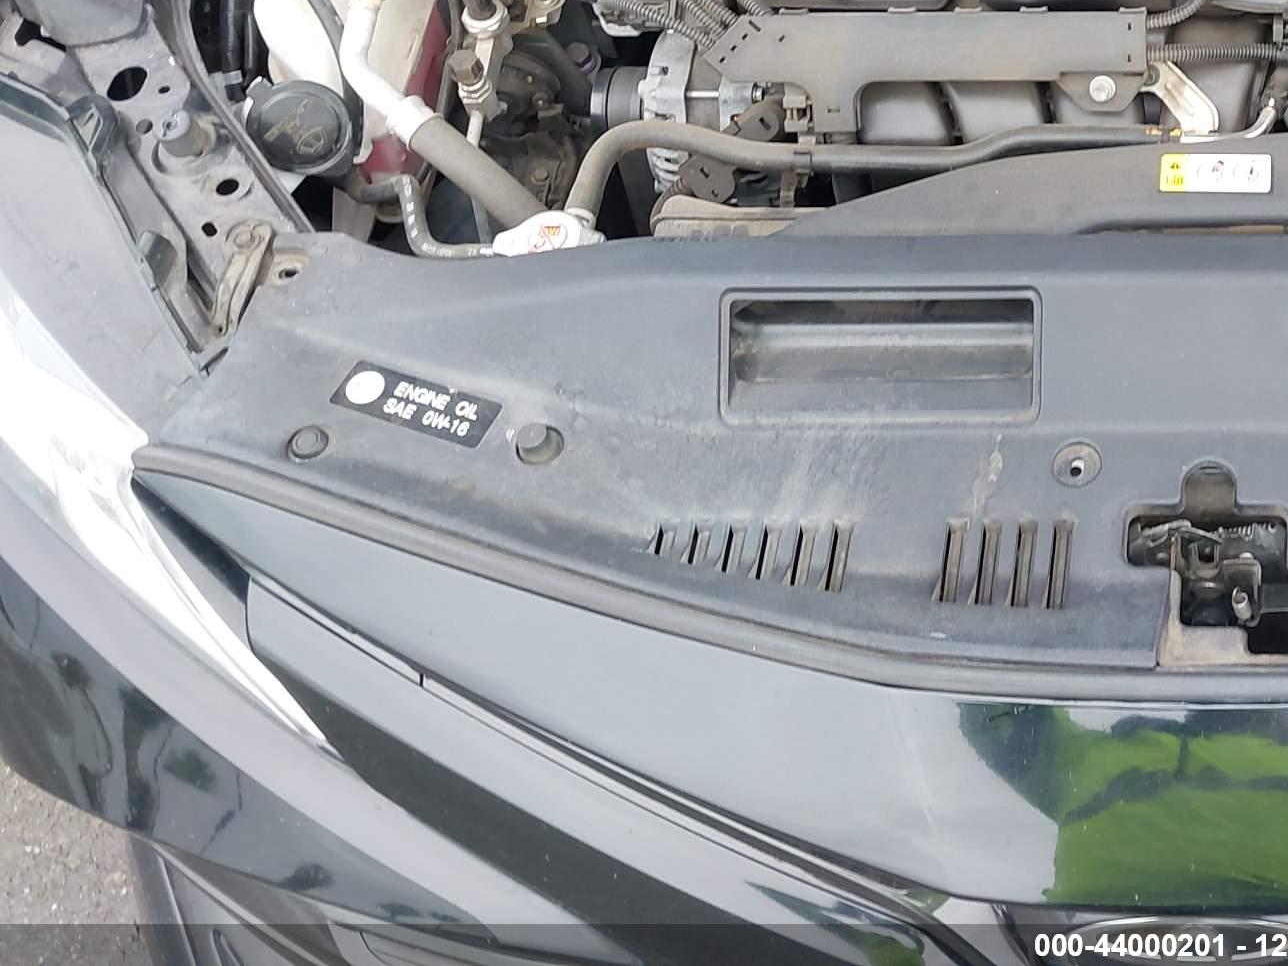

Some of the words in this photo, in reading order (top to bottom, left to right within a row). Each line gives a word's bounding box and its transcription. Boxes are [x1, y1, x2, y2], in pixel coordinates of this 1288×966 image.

[383, 397, 418, 420] SAE
[421, 410, 470, 437] 0W-16
[393, 381, 451, 411] ENGINE
[455, 400, 478, 421] OIL
